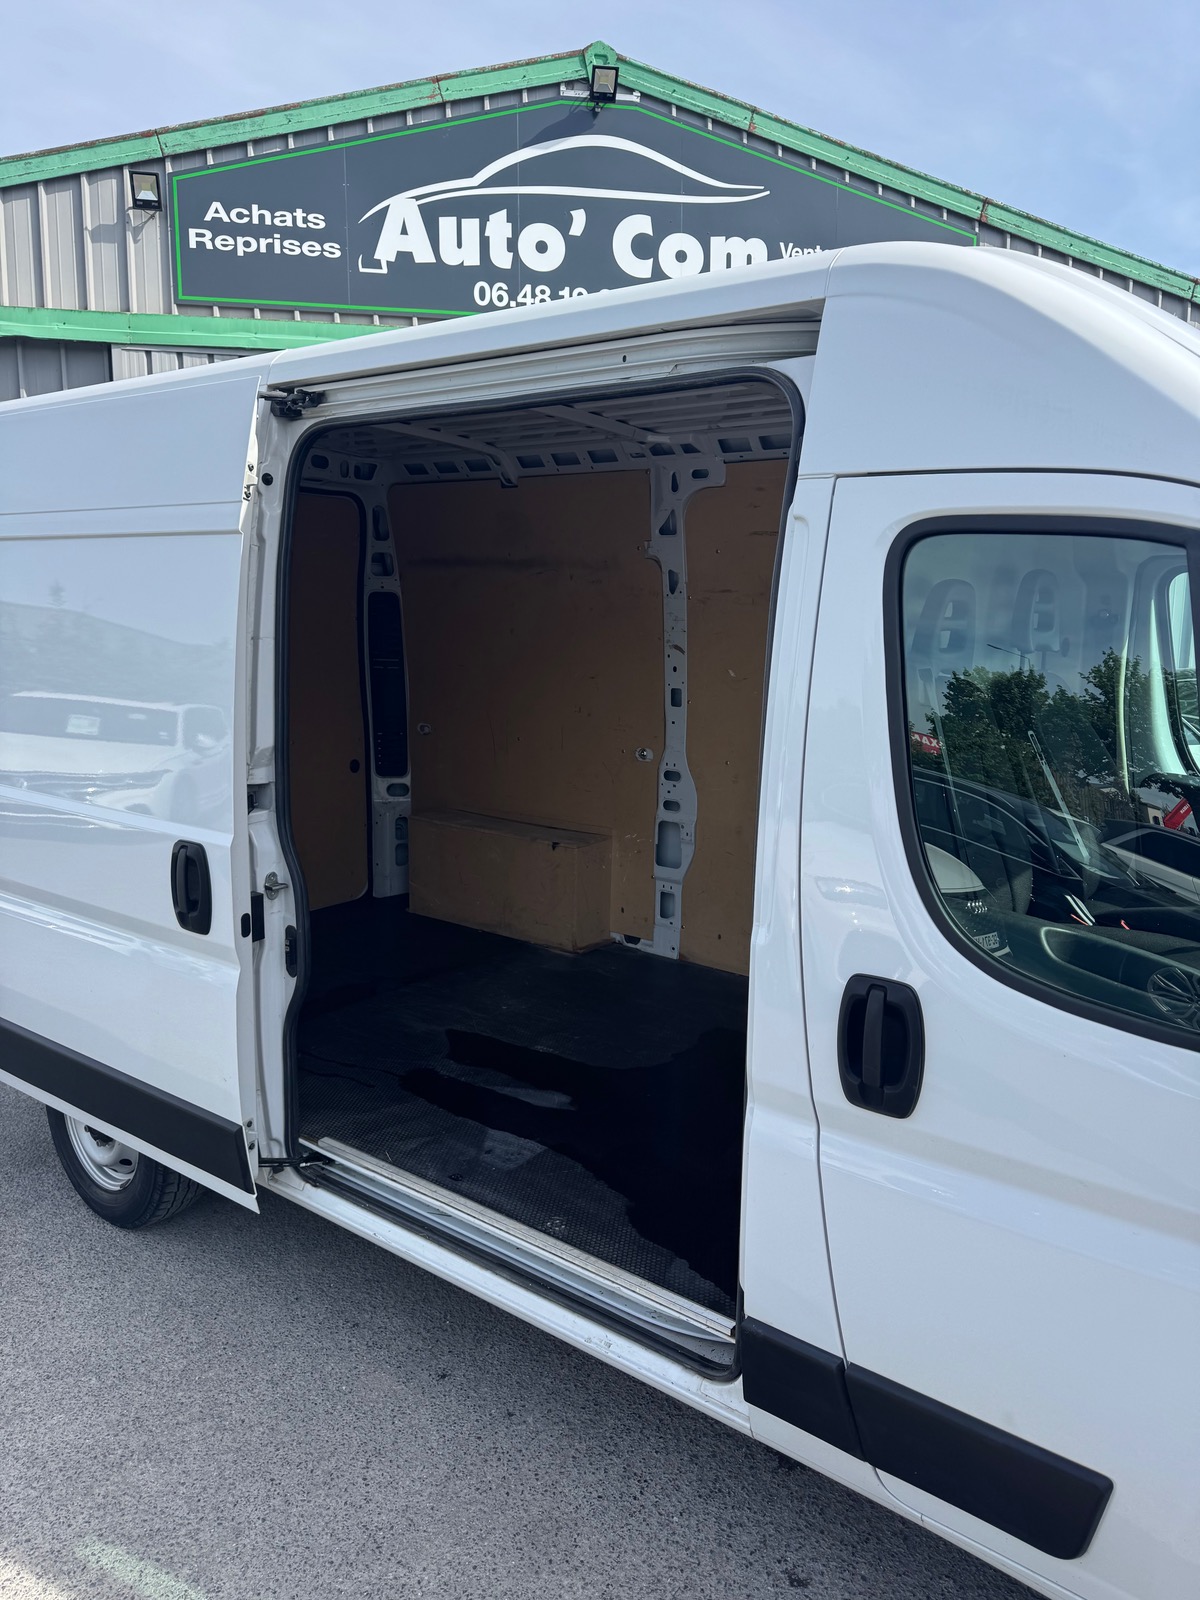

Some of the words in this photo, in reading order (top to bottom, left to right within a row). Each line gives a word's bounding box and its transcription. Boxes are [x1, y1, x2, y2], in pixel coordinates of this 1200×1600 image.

[203, 201, 326, 230] Achats
[187, 228, 342, 259] Reprises
[373, 198, 586, 273] Auto'
[611, 213, 768, 279] Com
